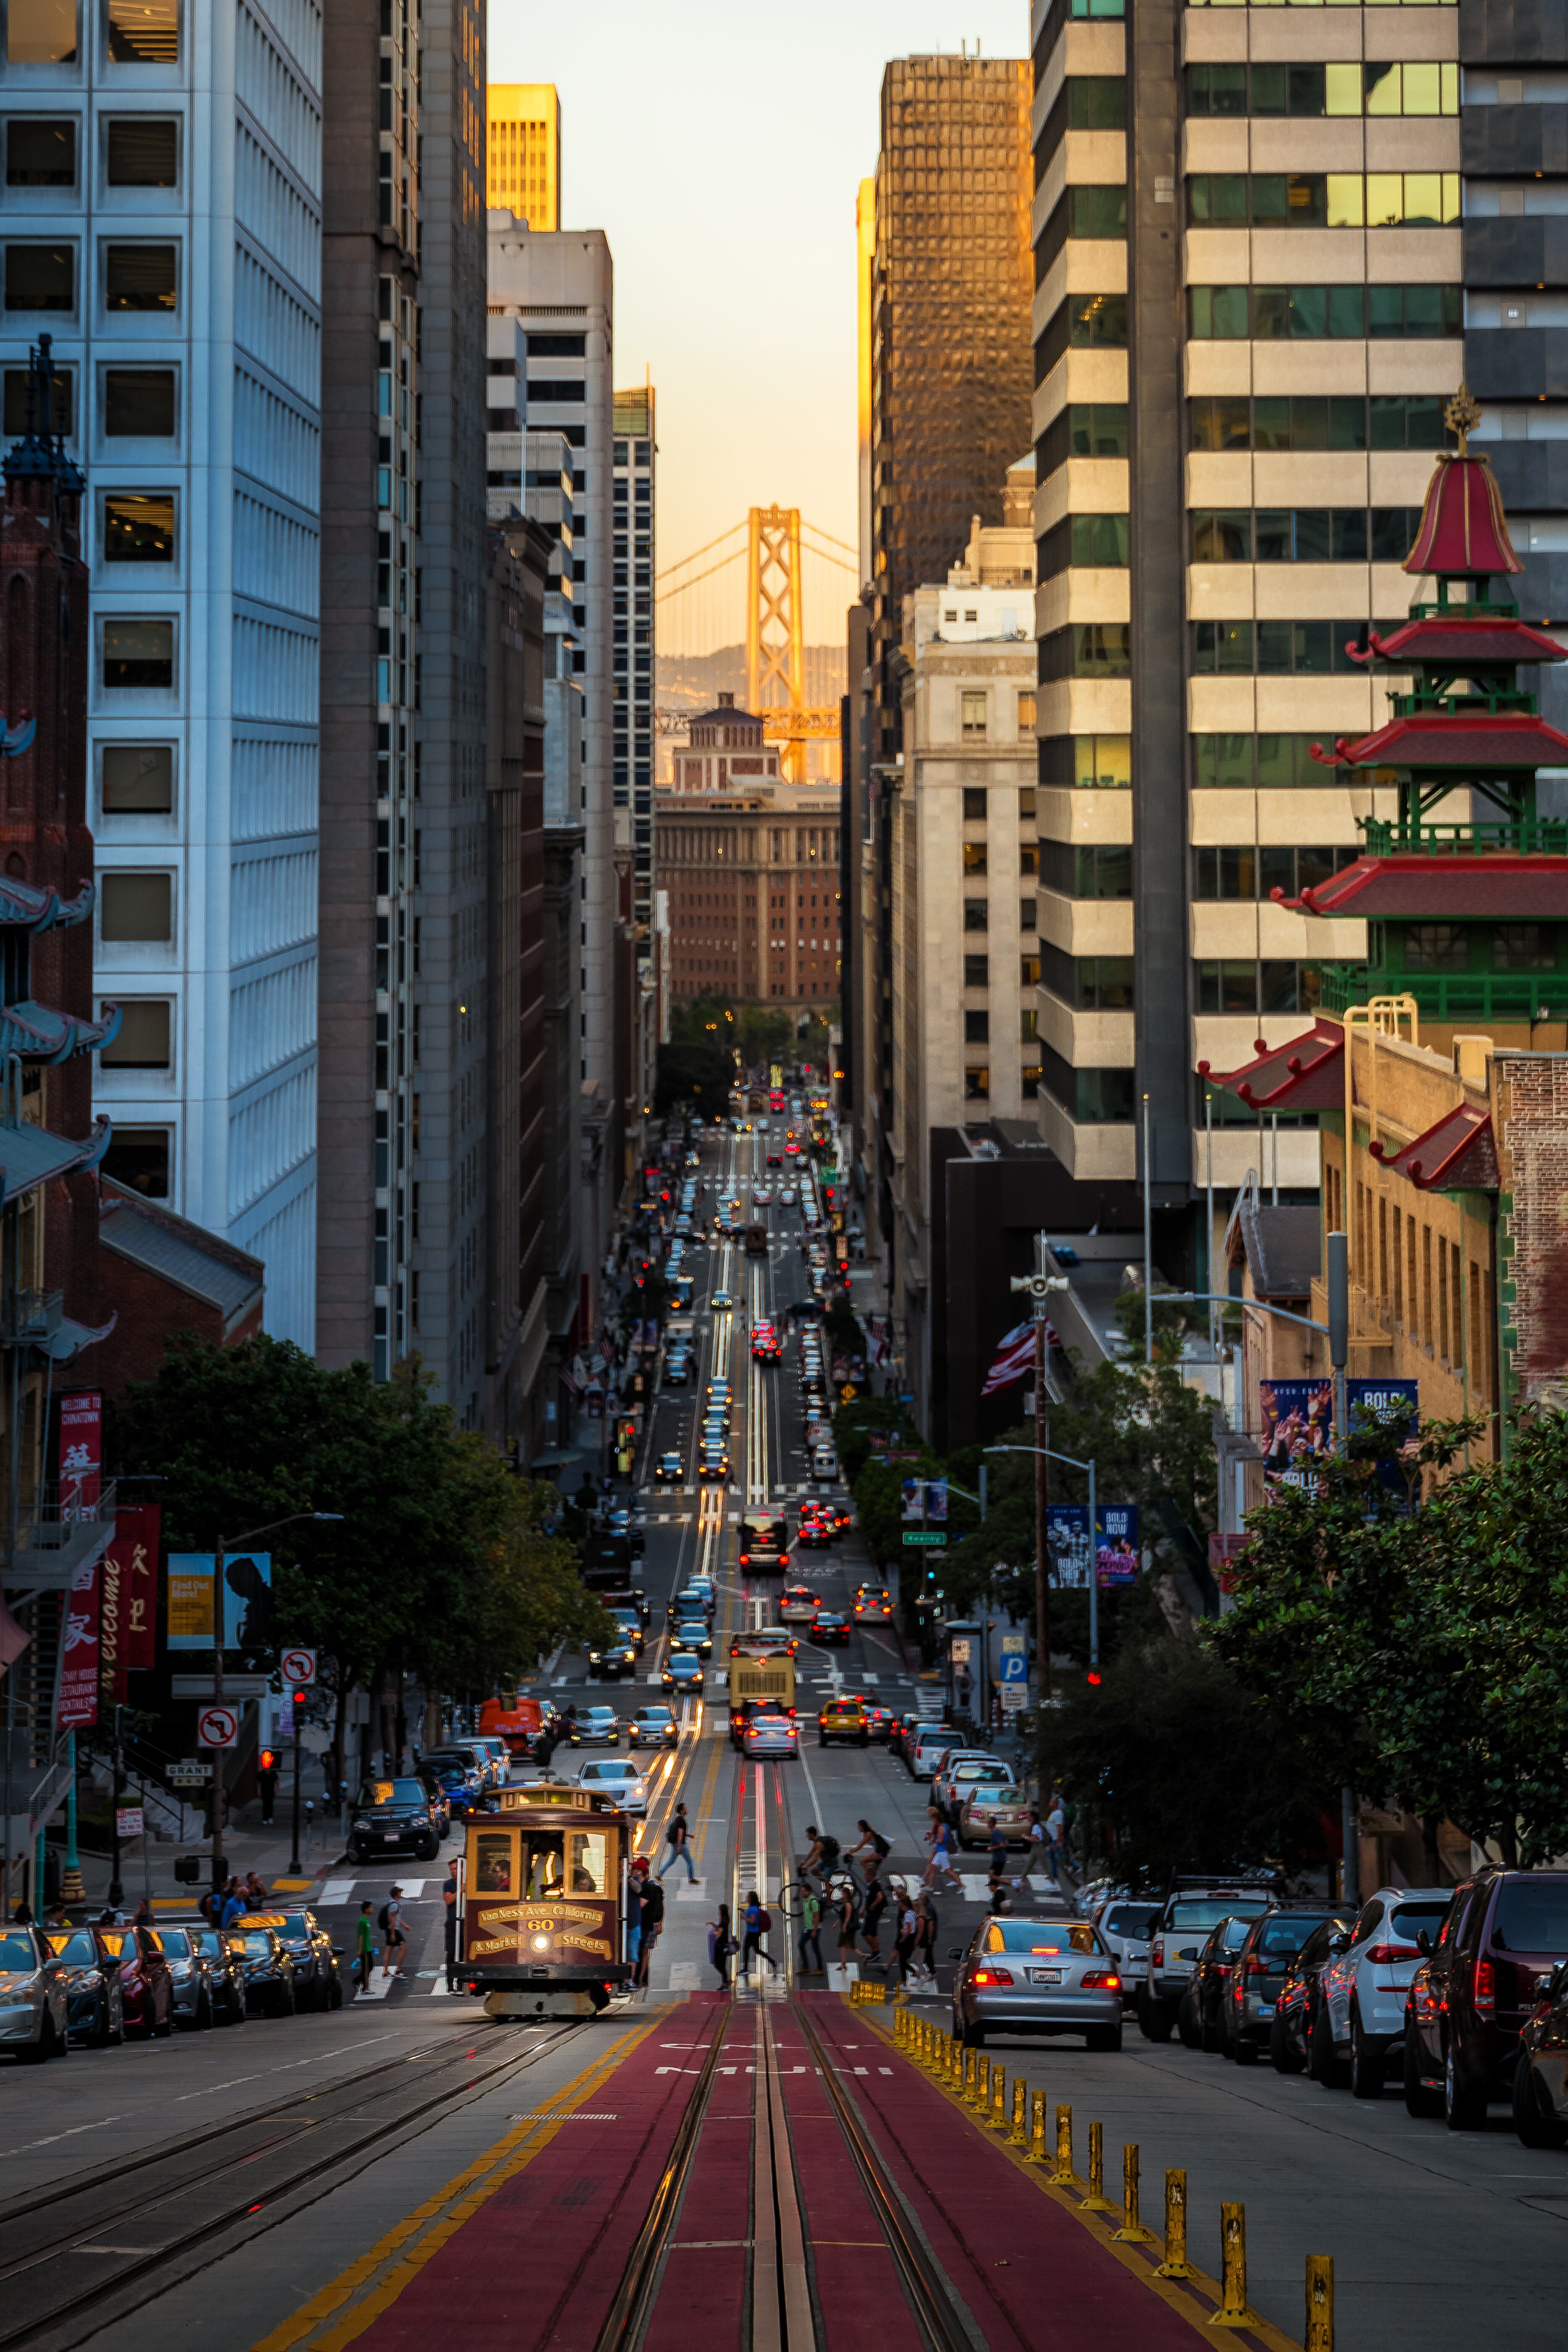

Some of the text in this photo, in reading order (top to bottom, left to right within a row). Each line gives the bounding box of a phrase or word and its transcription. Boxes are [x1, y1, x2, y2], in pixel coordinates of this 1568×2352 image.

[61, 1397, 101, 1411] WELCOME TO
[62, 1411, 99, 1425] CHINATOWN
[1106, 1512, 1128, 1523] BOLD
[1106, 1524, 1128, 1534] NOW
[1058, 1558, 1078, 1569] BOLD
[61, 1667, 98, 1682] THAY HOUSE
[1004, 1657, 1023, 1680] P
[59, 1681, 98, 1697] ESTAURANT
[58, 1697, 88, 1712] OCKTAILS
[553, 1906, 602, 1922] California
[527, 1920, 555, 1931] 60
[476, 1935, 605, 1952] & Market Streets
